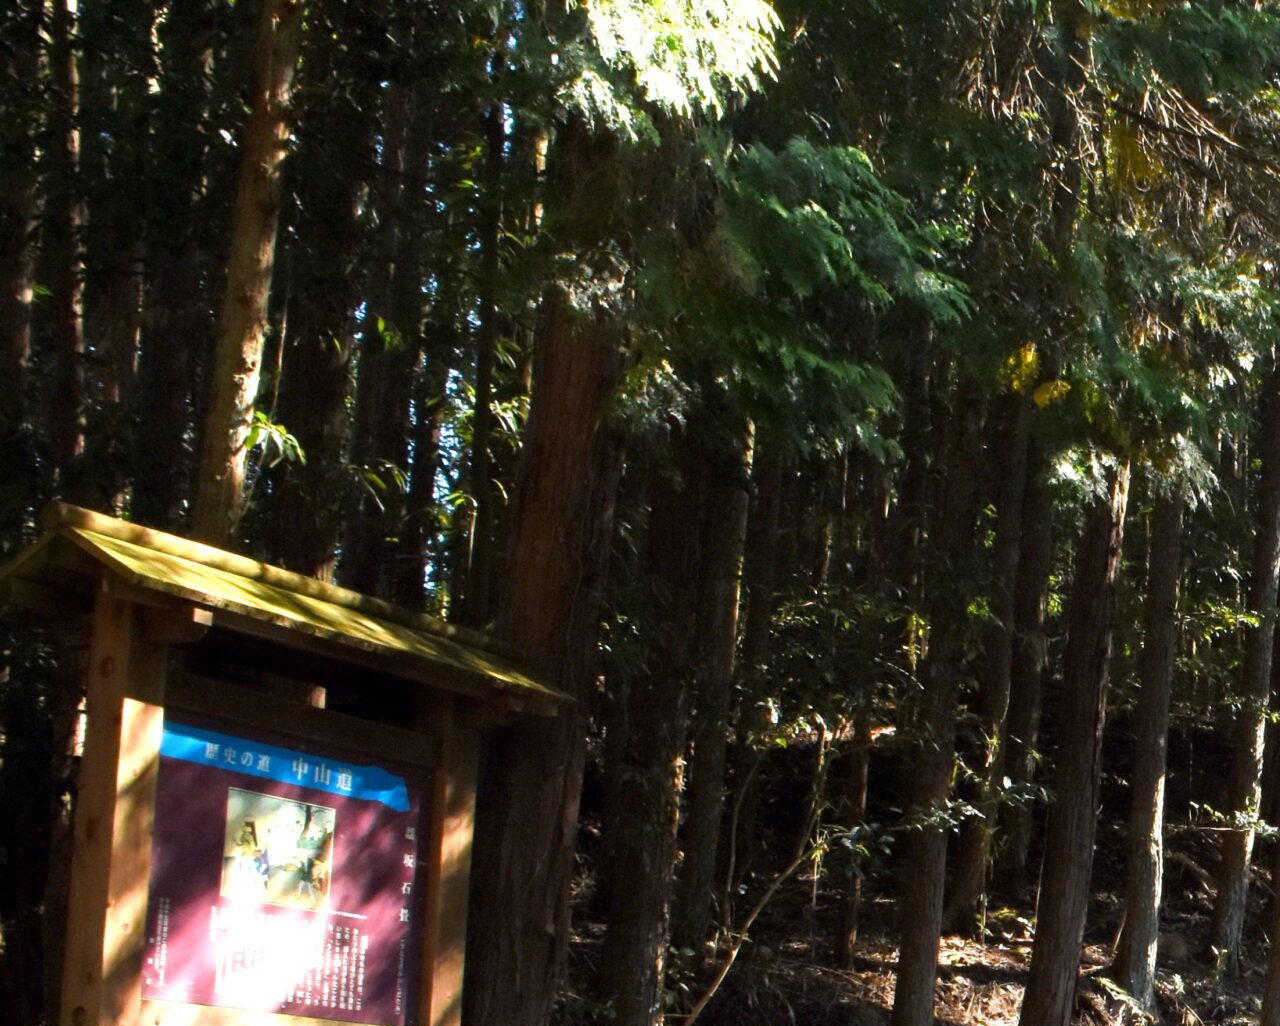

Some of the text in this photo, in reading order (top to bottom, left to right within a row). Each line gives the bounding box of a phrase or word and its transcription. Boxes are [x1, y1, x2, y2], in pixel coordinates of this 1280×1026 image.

[205, 742, 353, 792] 歴史の道 中山道
